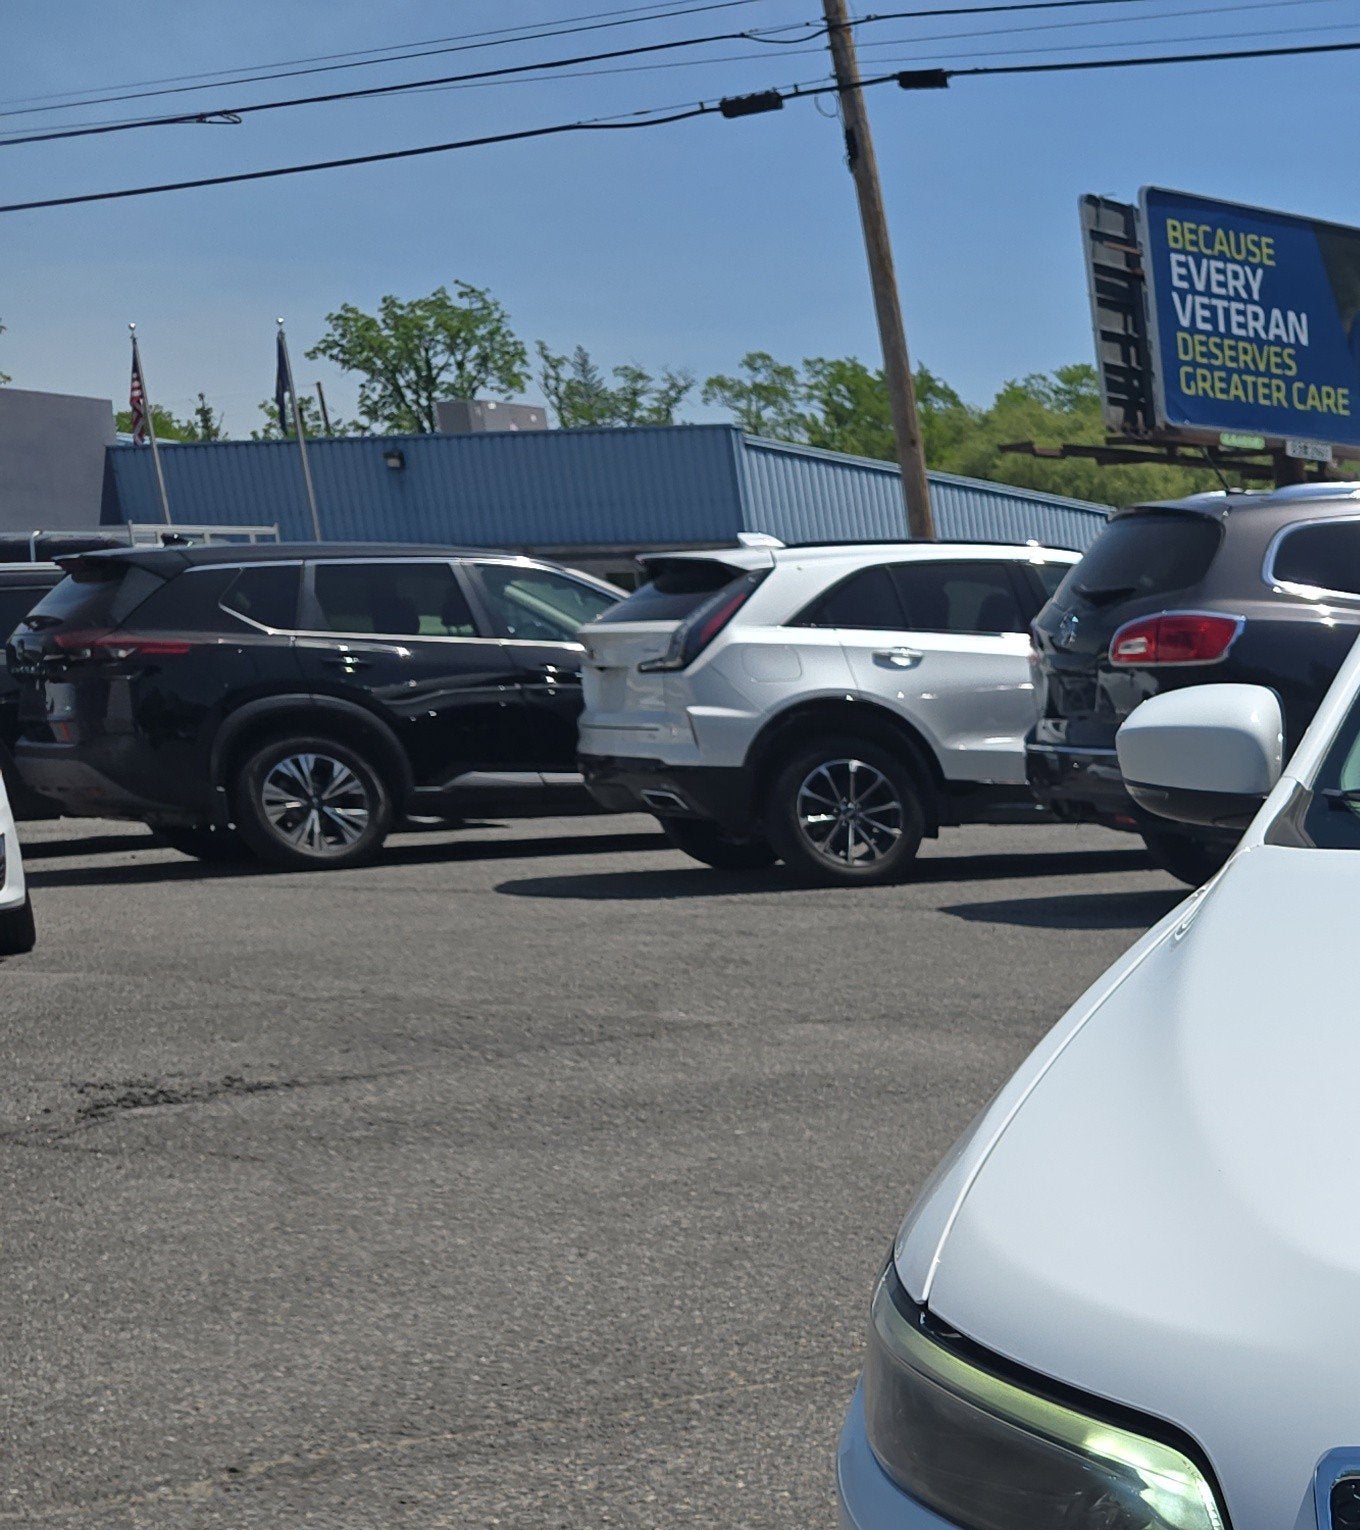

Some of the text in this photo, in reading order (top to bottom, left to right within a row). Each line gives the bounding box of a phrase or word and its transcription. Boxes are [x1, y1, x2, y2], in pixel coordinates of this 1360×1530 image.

[1166, 218, 1276, 266] BECAUSE
[1170, 252, 1263, 301] EVERY
[1172, 291, 1309, 347] VETERAN
[1176, 331, 1298, 377] DESERVES
[1179, 365, 1351, 416] GREATER CARE
